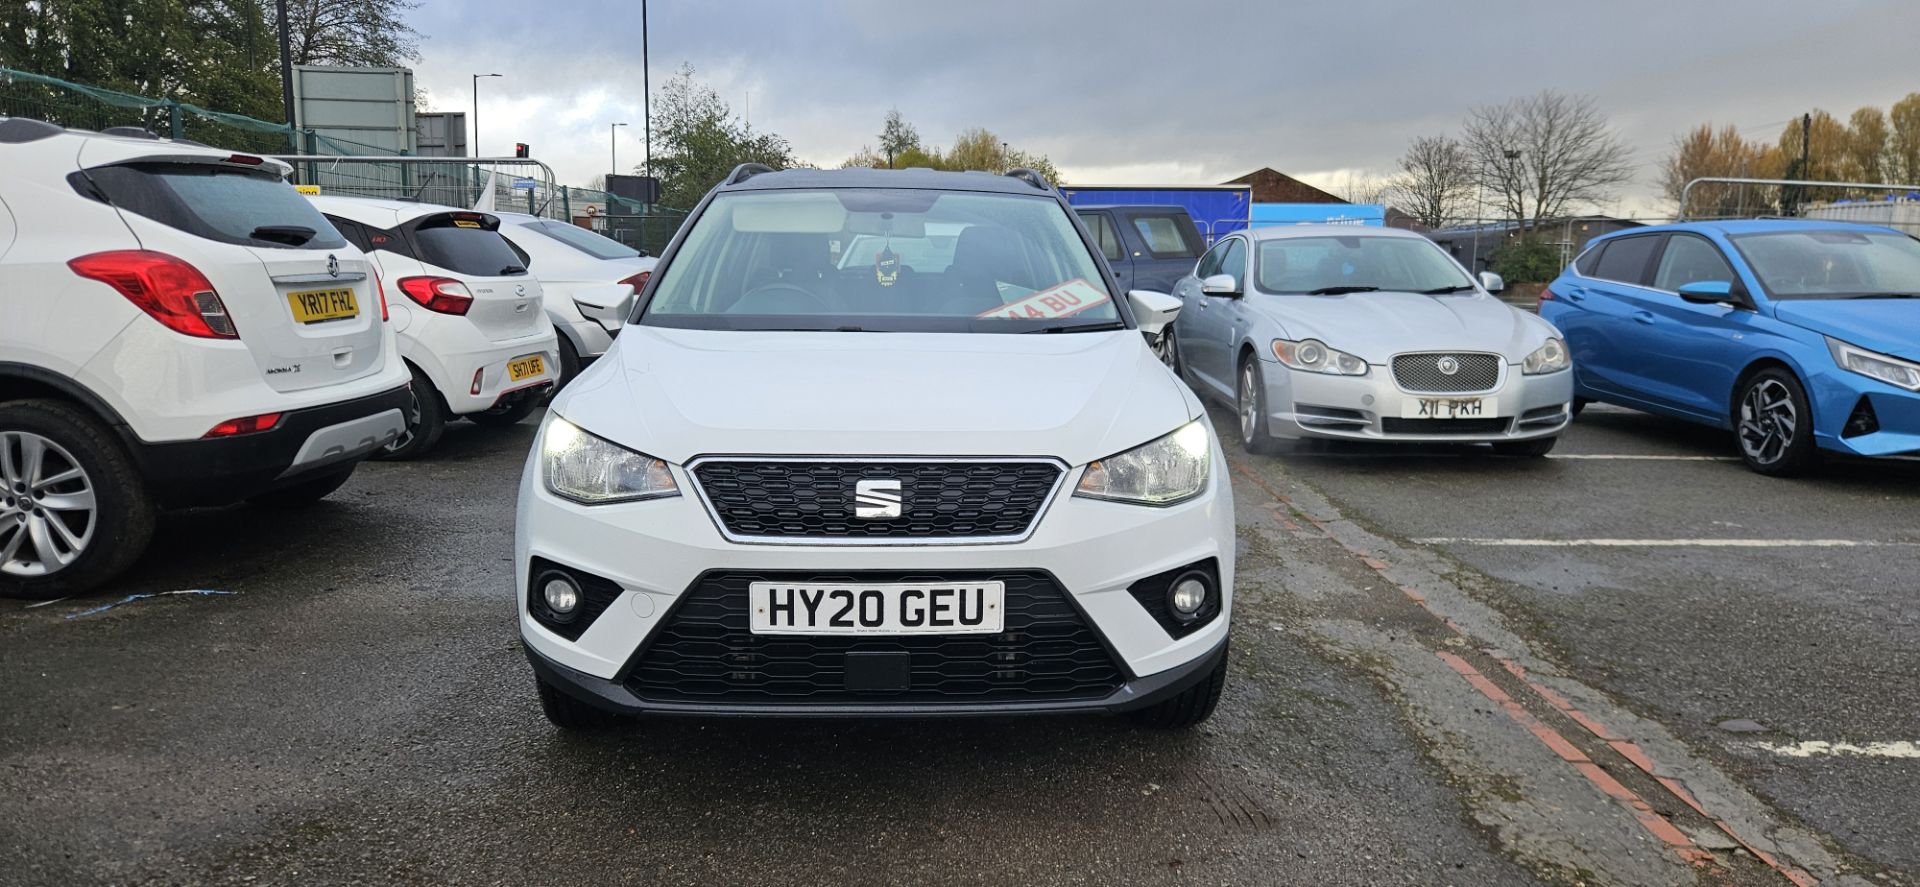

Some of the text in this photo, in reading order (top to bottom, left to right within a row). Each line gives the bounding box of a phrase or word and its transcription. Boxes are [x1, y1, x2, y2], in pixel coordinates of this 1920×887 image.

[297, 290, 354, 316] YR17 FHZ
[1038, 289, 1082, 313] BU
[512, 358, 542, 378] SH71 UFE
[1448, 399, 1482, 416] PKH
[769, 588, 985, 627] HY20 GEU
